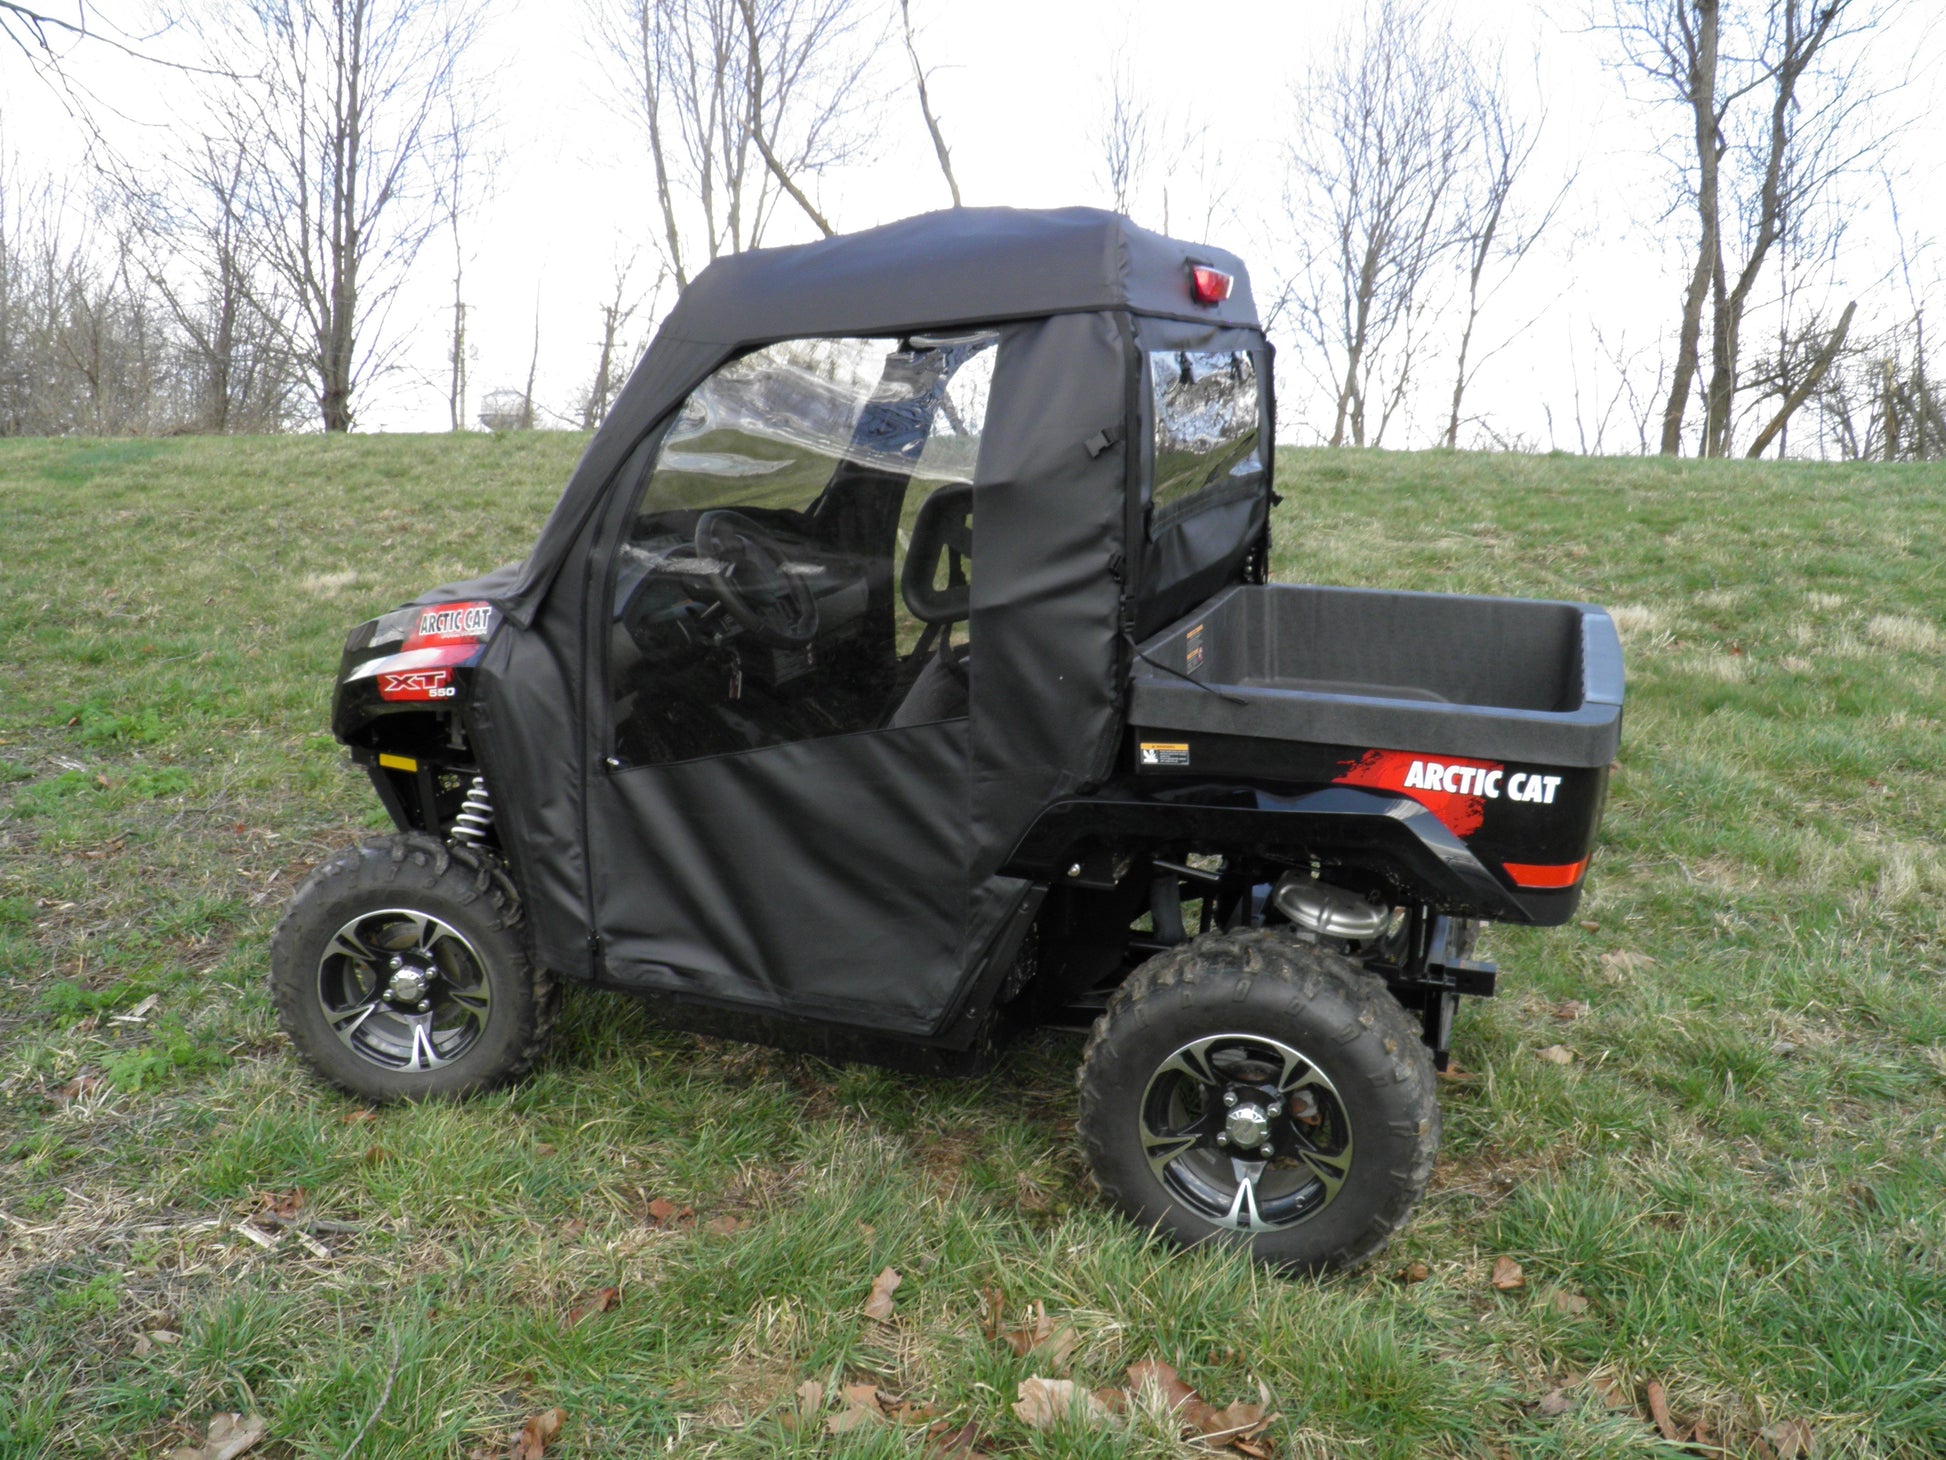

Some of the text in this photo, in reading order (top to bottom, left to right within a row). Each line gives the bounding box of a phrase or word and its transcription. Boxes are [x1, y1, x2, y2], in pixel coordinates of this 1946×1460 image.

[419, 607, 492, 635] ARCTIC CAT
[384, 671, 446, 691] XT
[1403, 760, 1562, 804] ARCTIC CAT
